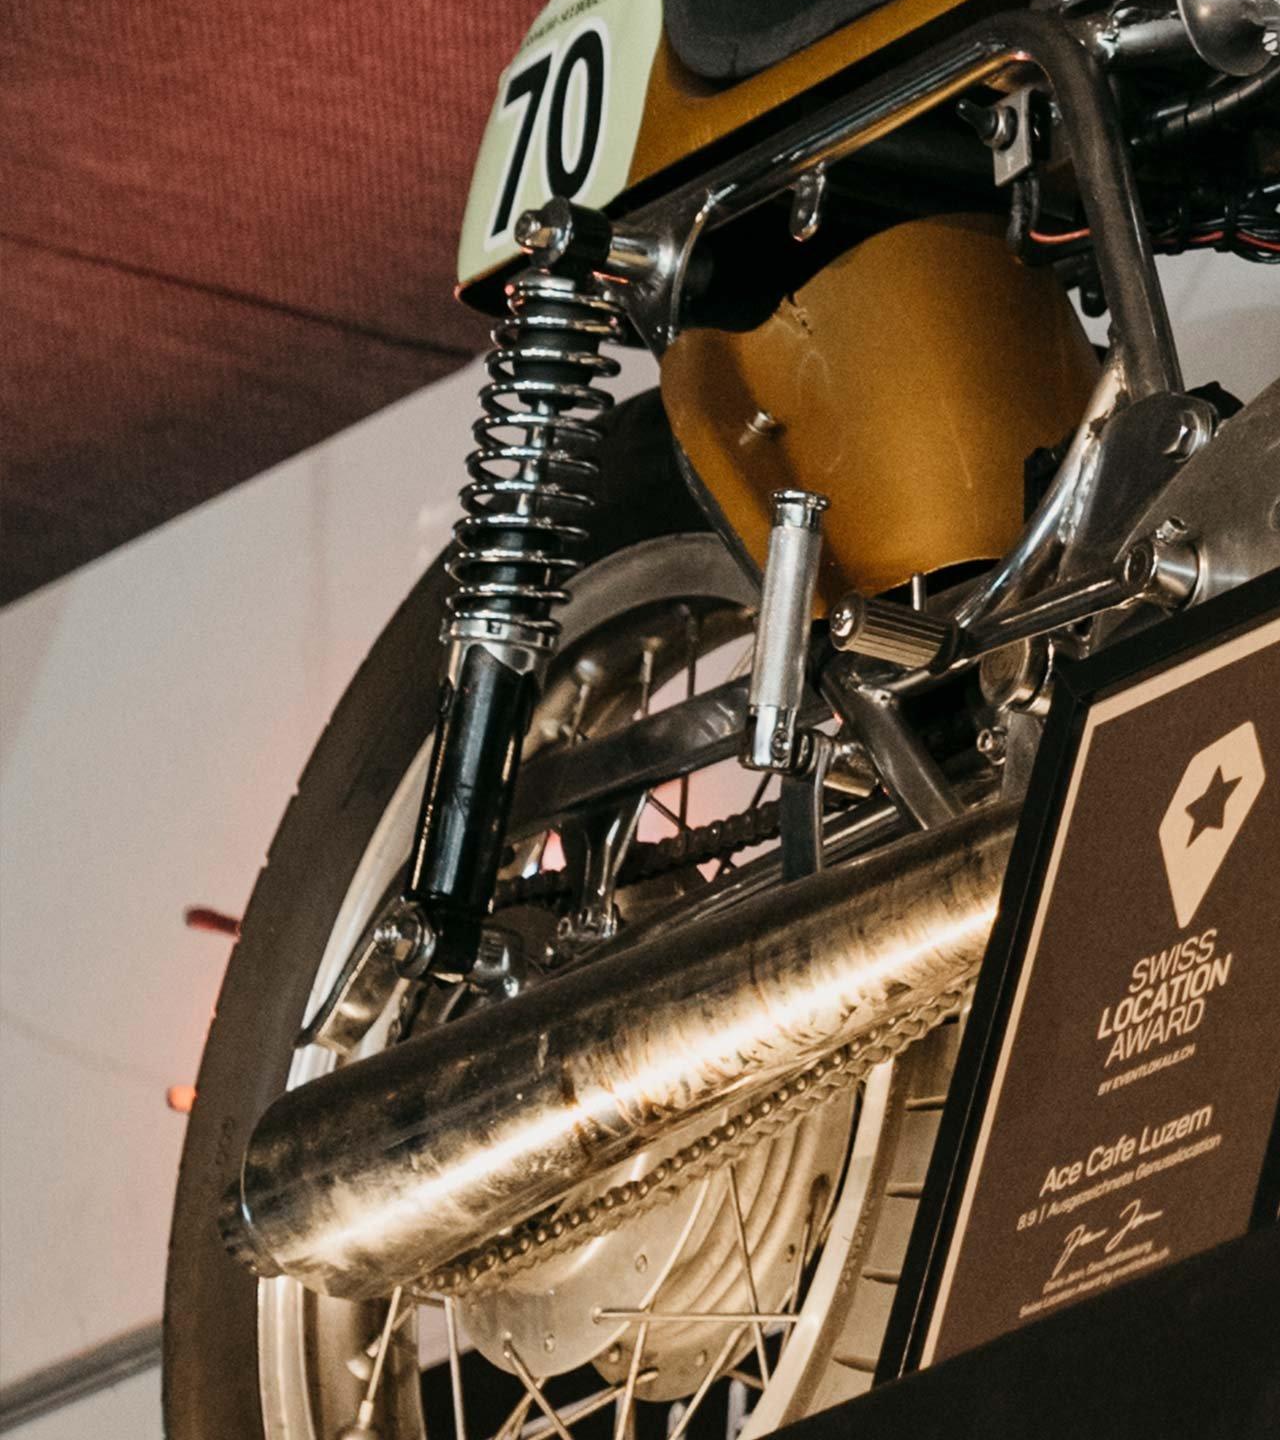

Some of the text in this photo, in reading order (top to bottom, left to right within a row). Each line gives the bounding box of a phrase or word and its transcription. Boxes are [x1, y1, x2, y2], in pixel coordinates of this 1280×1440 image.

[490, 29, 605, 238] 70
[1097, 952, 1233, 1040] LOCATION
[1129, 928, 1218, 993] SWISS
[1104, 998, 1205, 1068] AWARD
[1039, 1104, 1213, 1198] Ace Cafe Luzern
